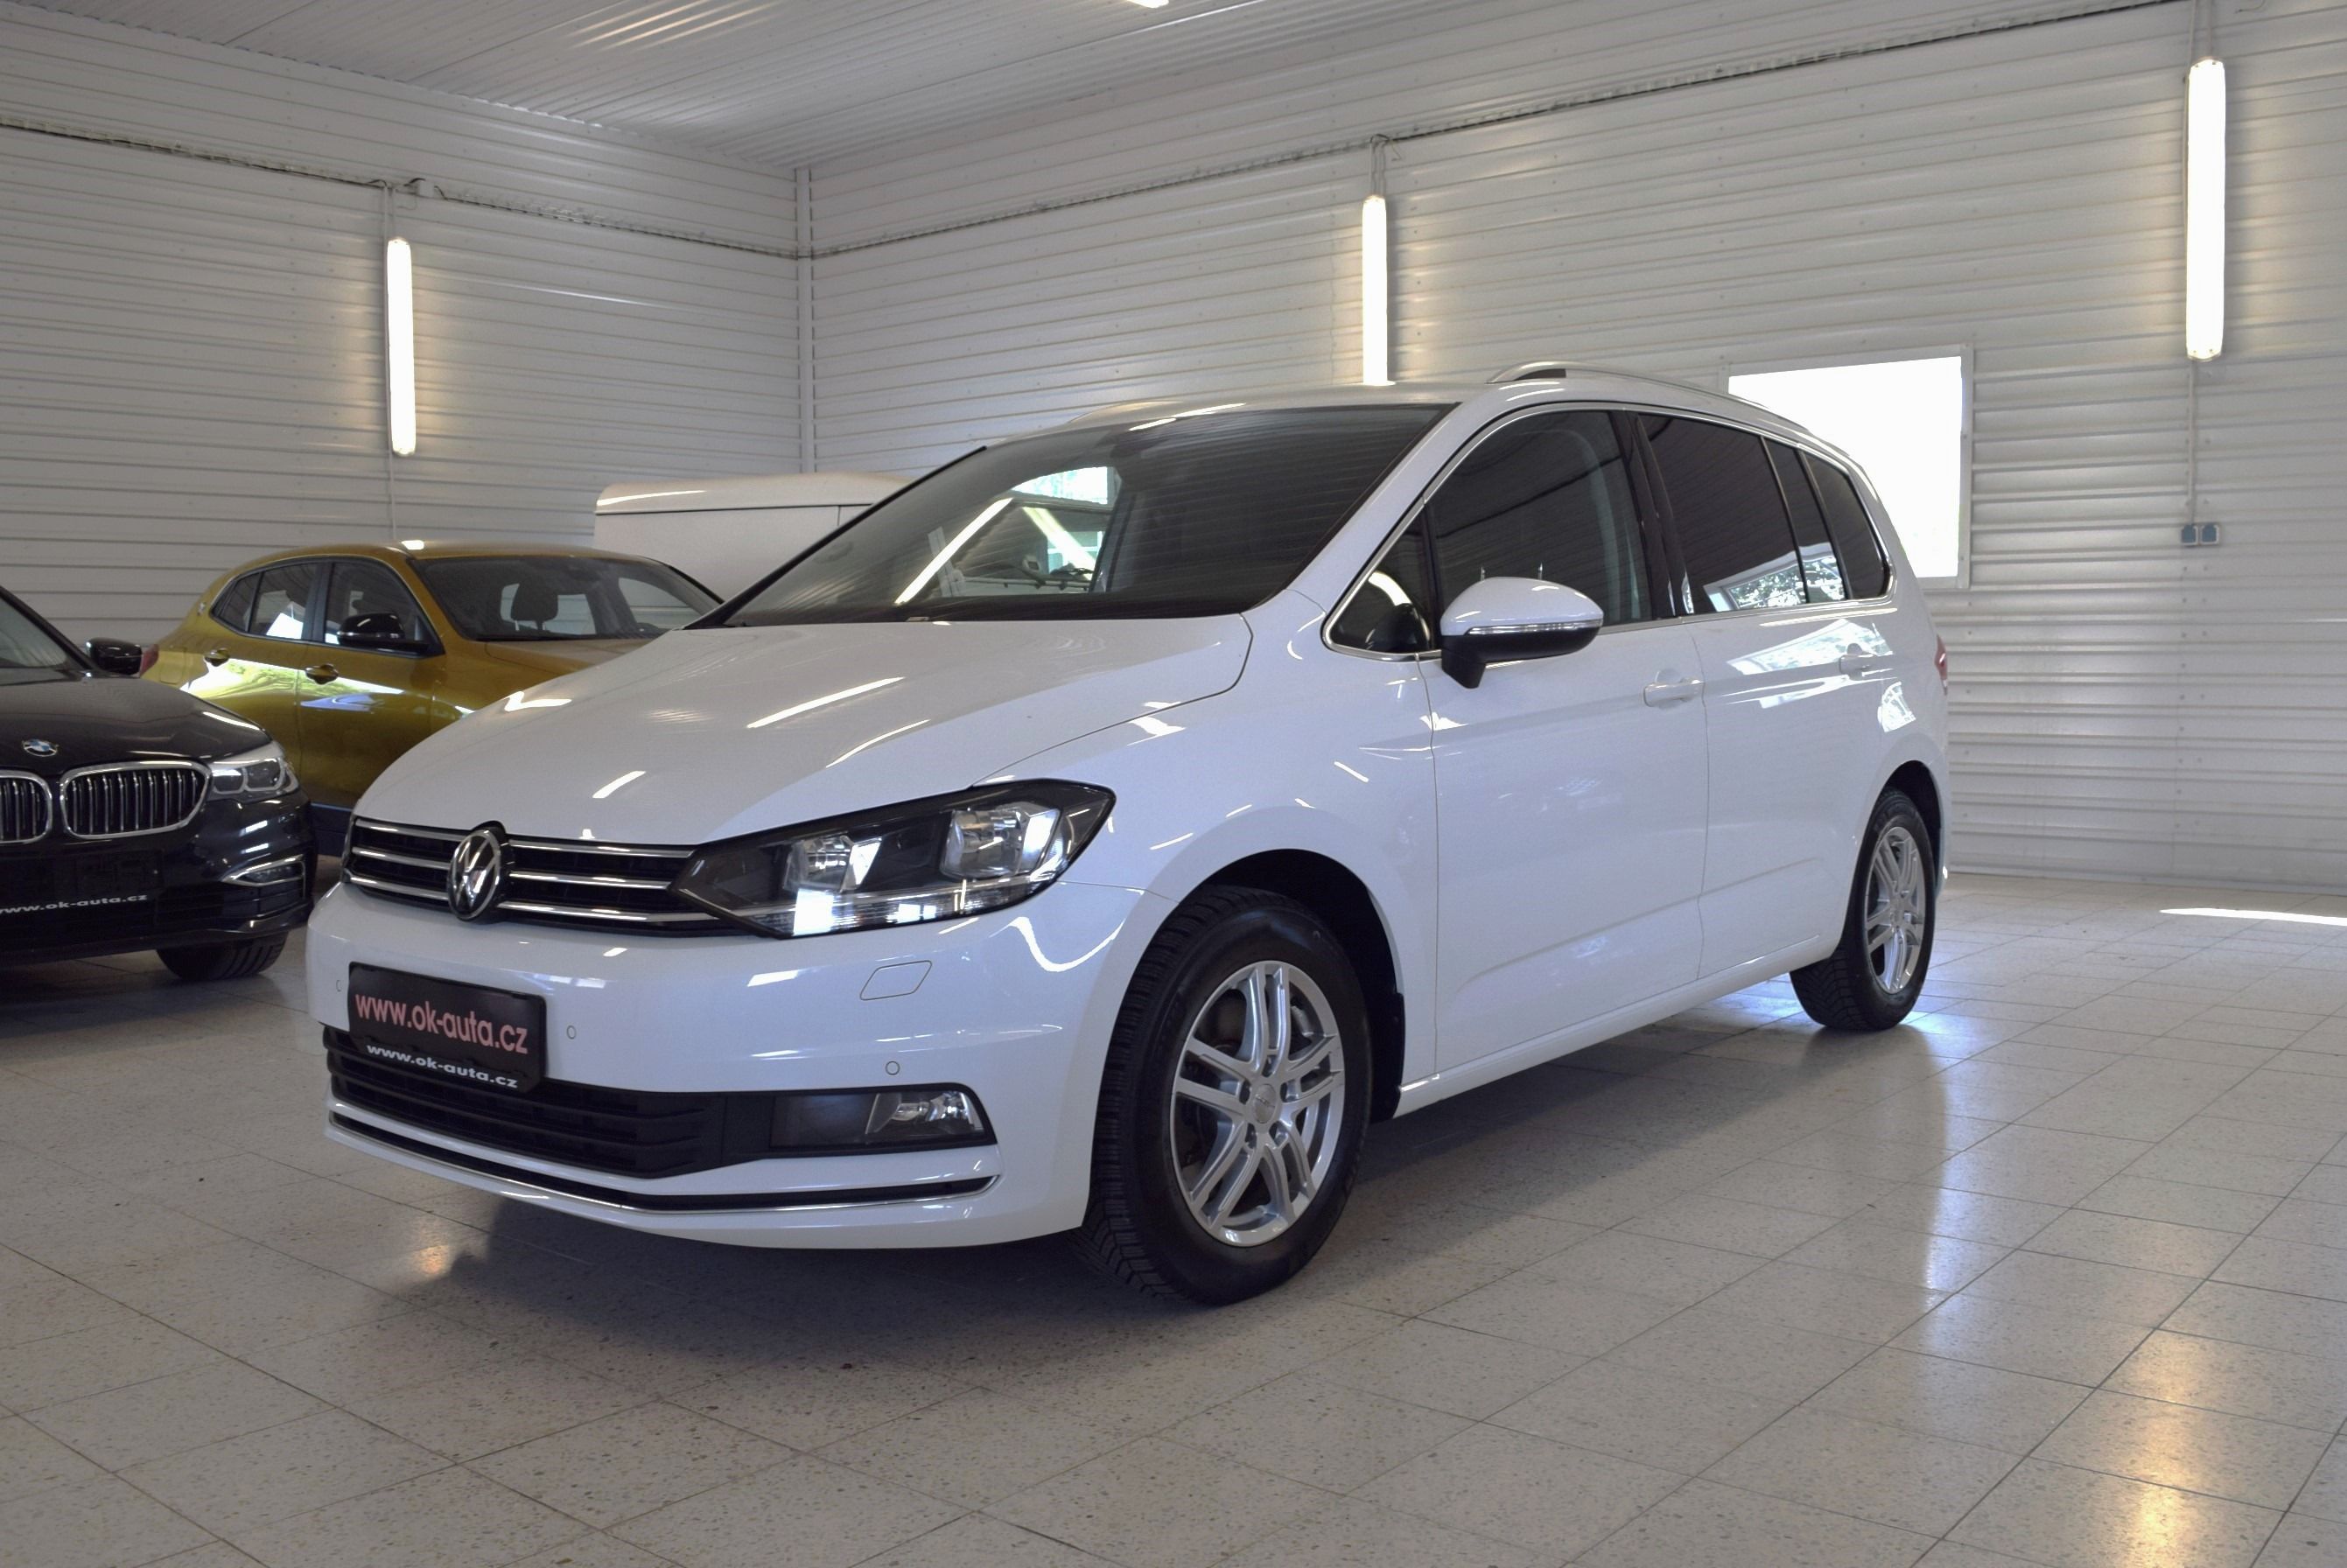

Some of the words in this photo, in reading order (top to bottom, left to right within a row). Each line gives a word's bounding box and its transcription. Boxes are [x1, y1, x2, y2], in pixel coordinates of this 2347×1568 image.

[0, 894, 147, 914] ww.ok-auta.cz
[355, 994, 529, 1054] www.ok-auta.cz
[367, 1045, 518, 1088] www.ok-auta.cz
